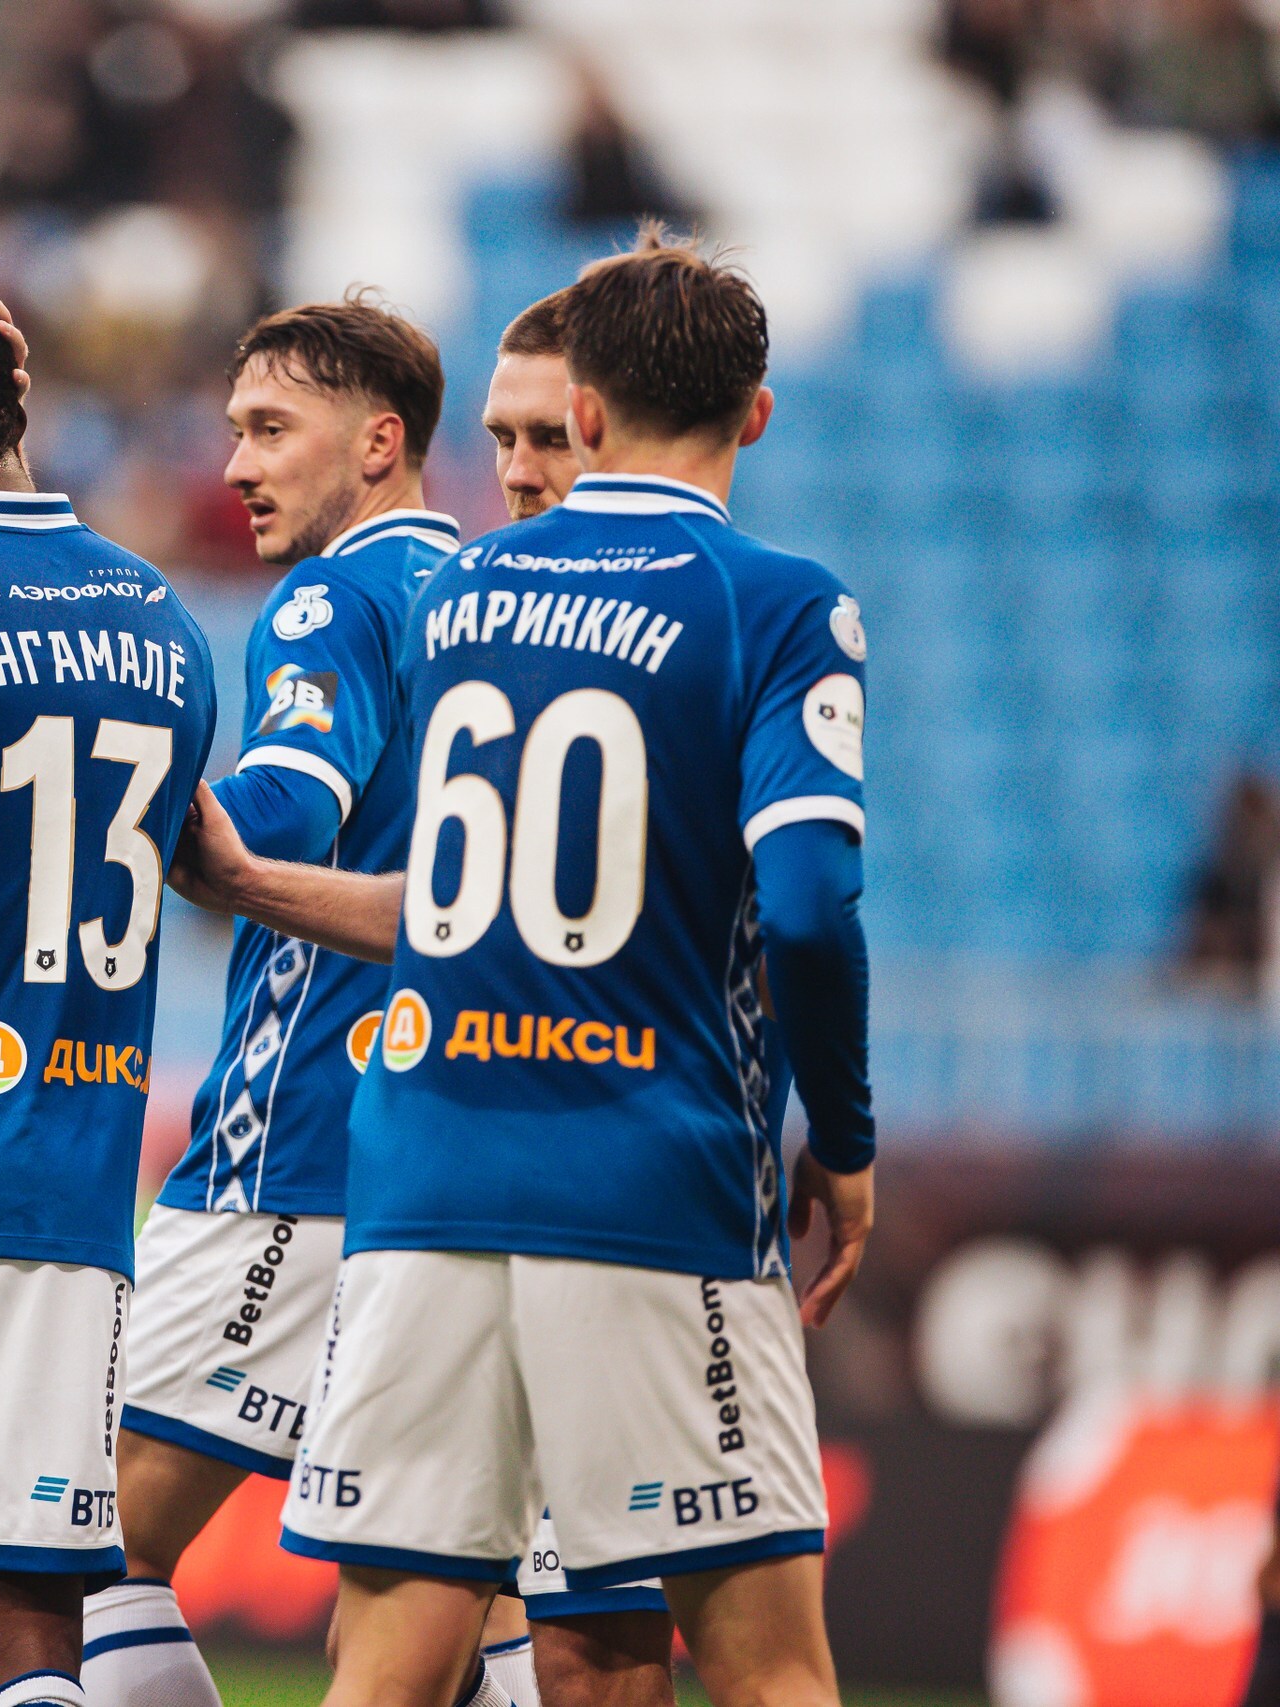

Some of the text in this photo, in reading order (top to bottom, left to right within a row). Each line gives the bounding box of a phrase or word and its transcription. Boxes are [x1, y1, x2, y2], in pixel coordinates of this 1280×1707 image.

[89, 567, 140, 578] ГРУППА
[491, 552, 650, 574] АЭРОФЛОТ
[8, 582, 143, 601] АЭРОФЛОТ
[426, 590, 684, 675] МАРИНКИН
[269, 679, 325, 716] BB
[404, 680, 649, 968] 60
[0, 715, 173, 992] 13
[223, 1215, 298, 1346] BetBoo
[701, 1277, 745, 1453] BetBoom
[71, 1489, 116, 1528] ВТБ
[673, 1477, 758, 1527] ВТБ
[533, 1549, 565, 1573] ВО
